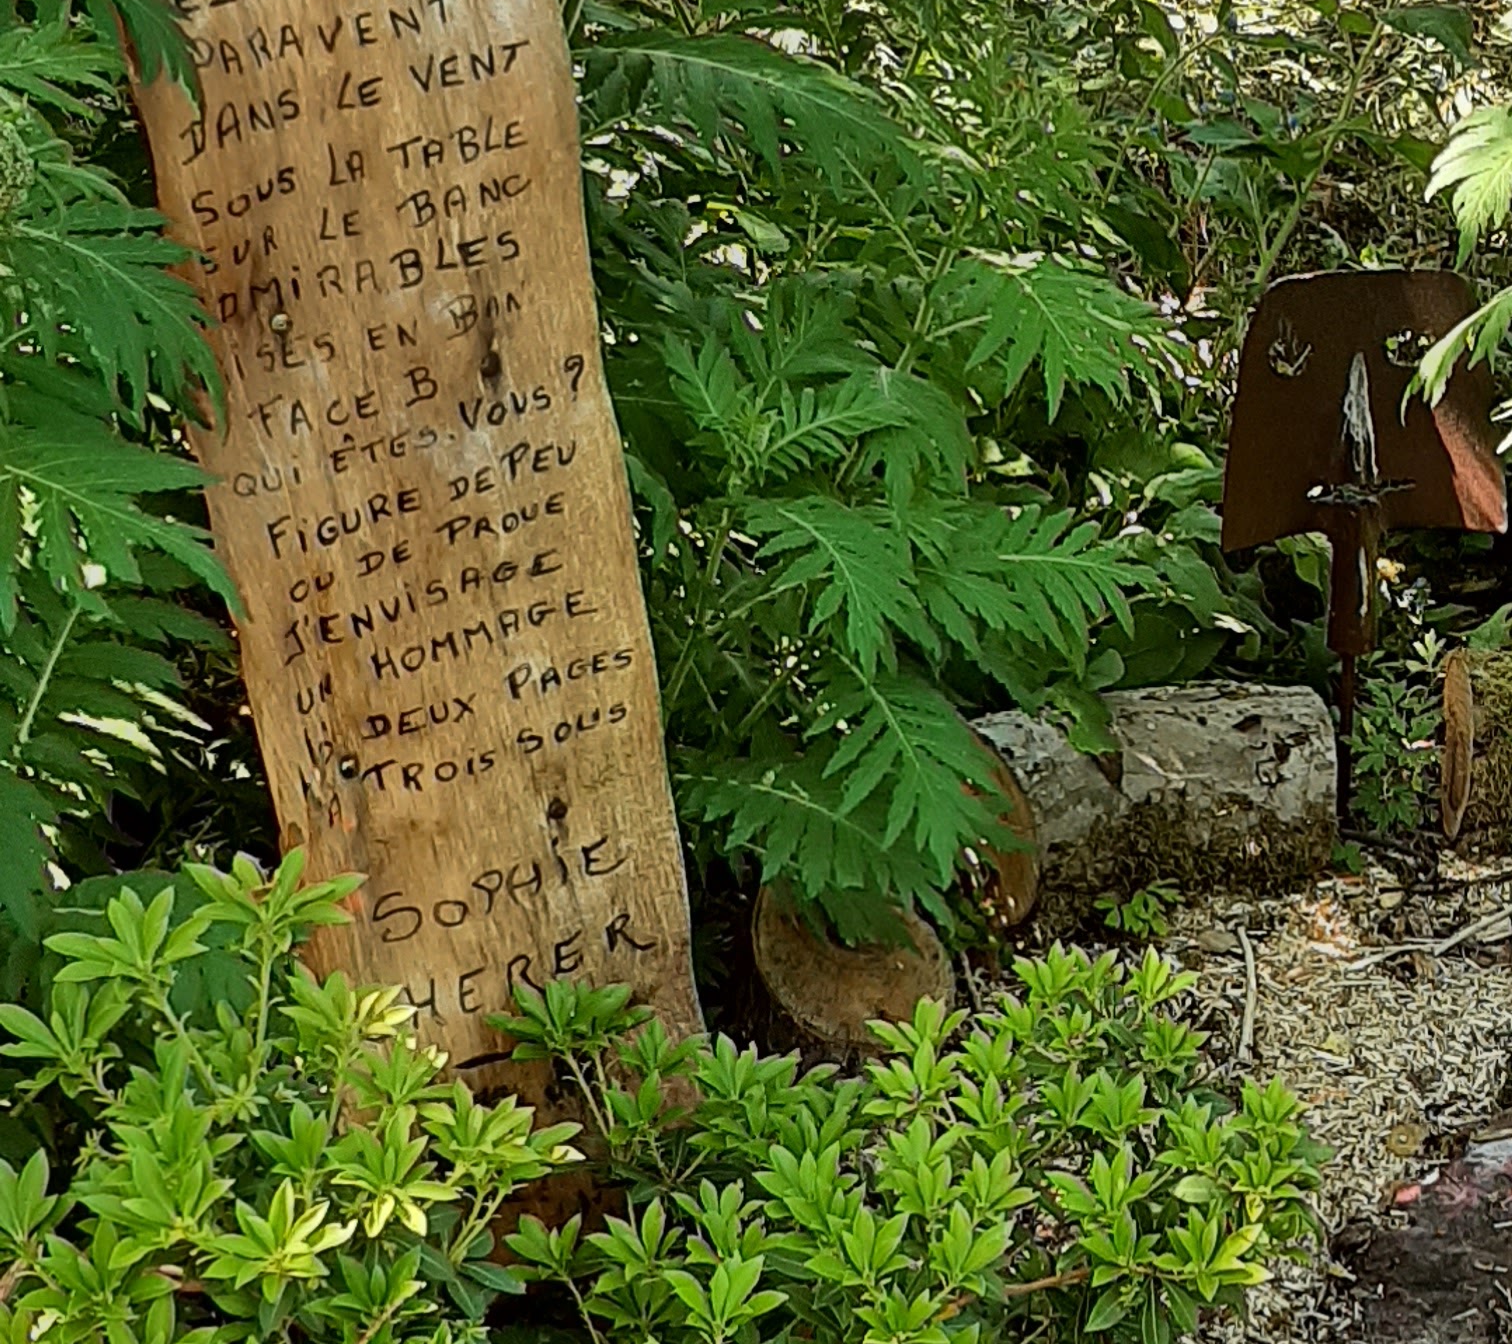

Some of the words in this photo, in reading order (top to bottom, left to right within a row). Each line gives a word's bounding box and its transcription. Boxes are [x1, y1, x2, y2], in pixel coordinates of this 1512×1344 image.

[179, 88, 301, 166] DANS
[337, 71, 383, 111] LE
[409, 40, 530, 94] VENT
[191, 166, 296, 227] SOUS
[328, 142, 366, 186] LA
[386, 115, 529, 170] TABLE
[319, 208, 361, 241] LE
[396, 173, 533, 228] BANC
[200, 230, 521, 329] DMIRABLES
[367, 315, 418, 351] EN
[247, 389, 380, 441] FACE
[404, 365, 439, 409] B
[266, 487, 422, 560] FIGURE
[448, 465, 497, 503] DE
[499, 440, 578, 481] PEU
[290, 573, 334, 604] OU
[356, 540, 413, 579] DE
[435, 490, 566, 546] PROUE
[370, 588, 599, 681] HOMMAGE
[361, 692, 478, 741] DEUX
[504, 647, 635, 701] PAGES
[361, 746, 497, 794] TROIS
[517, 702, 628, 755] SOUS
[372, 835, 628, 944] SOPHIE
